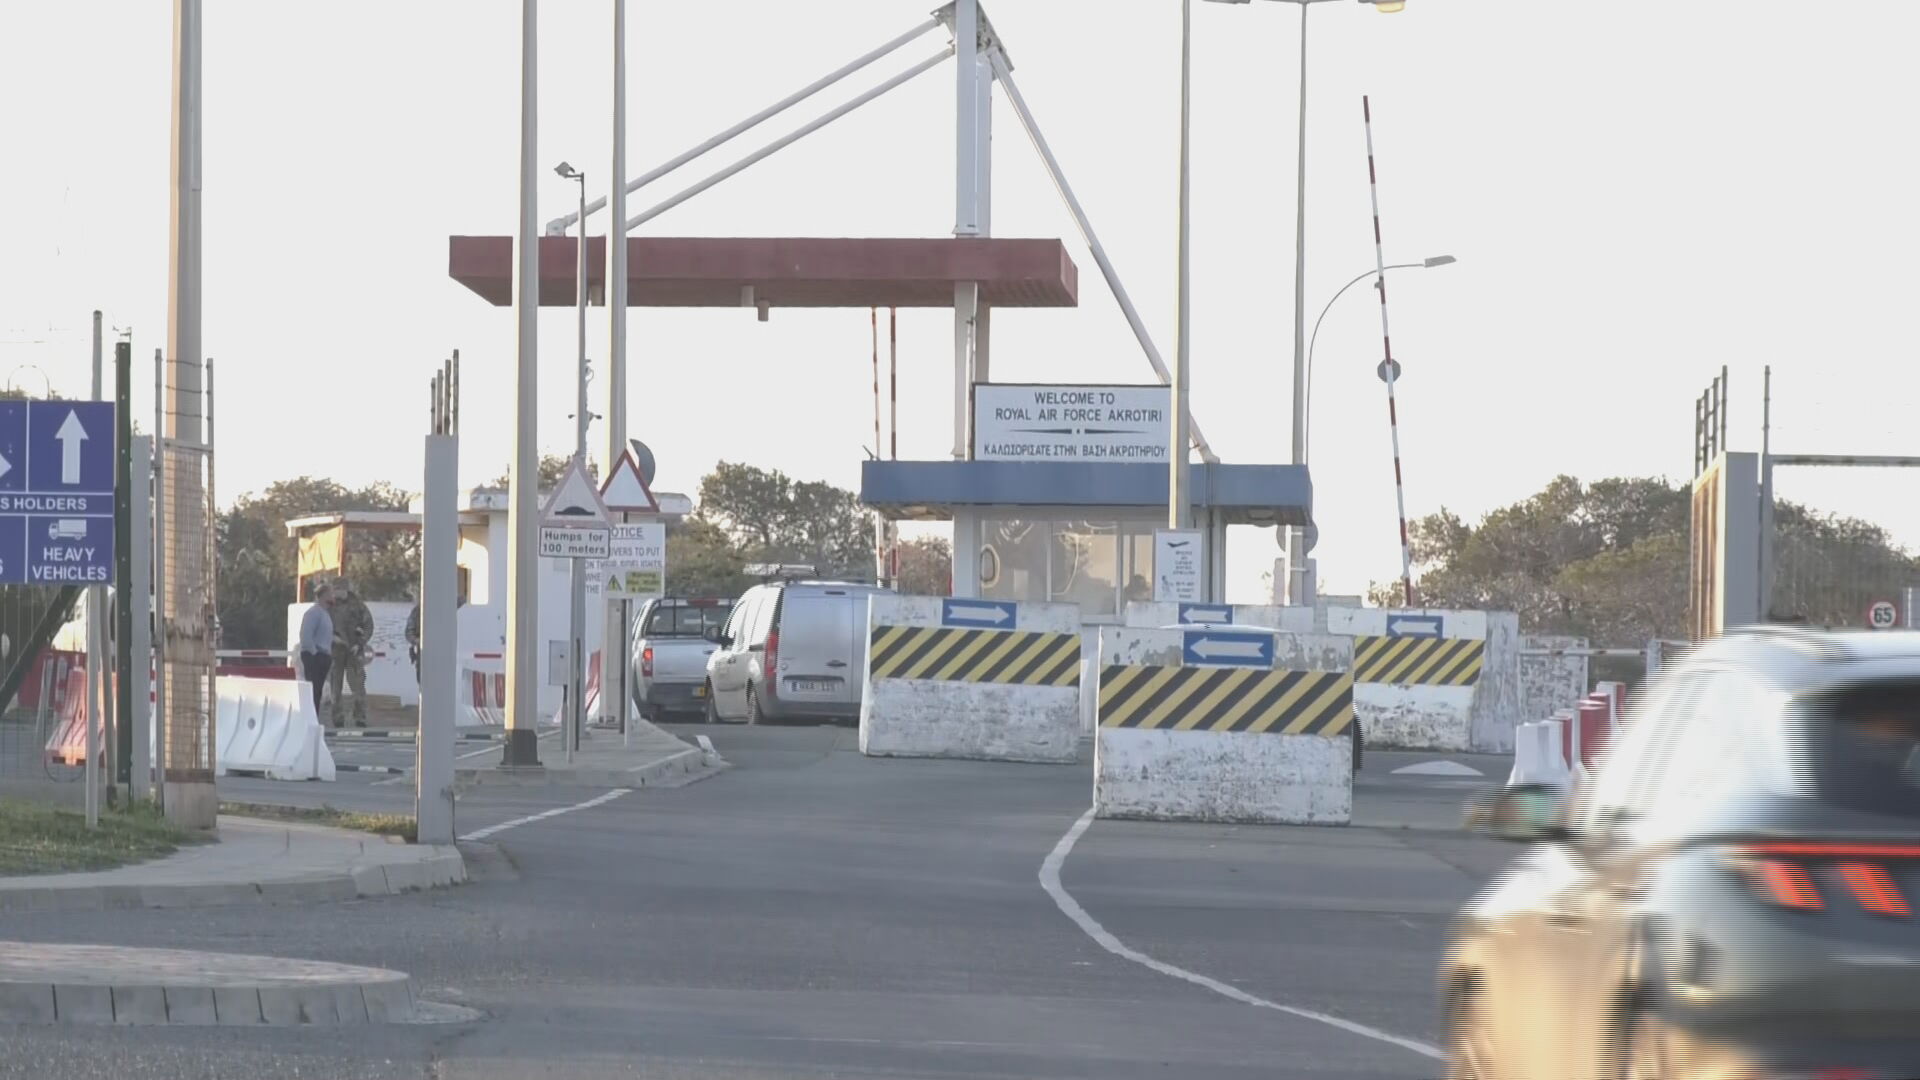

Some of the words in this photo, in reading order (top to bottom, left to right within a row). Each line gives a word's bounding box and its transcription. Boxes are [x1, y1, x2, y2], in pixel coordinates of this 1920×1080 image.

[1034, 391, 1095, 405] WELCOME
[1098, 392, 1115, 405] TO
[995, 408, 1031, 421] ROYAL
[1038, 408, 1057, 420] AIR
[1063, 408, 1101, 422] FORCE
[1108, 409, 1163, 423] AKROTIRI
[1053, 444, 1078, 456] ΣΤΗΝ
[1082, 444, 1107, 457] ΒΑΣΗ
[1109, 445, 1166, 457] ΑΚΡΩΤΗΡΙΟΥ
[0, 497, 10, 510] S
[14, 497, 87, 511] HOLDERS
[544, 530, 582, 542] Humps
[588, 532, 604, 542] for
[610, 527, 643, 538] OTICE
[43, 547, 95, 561] HEAVY
[543, 543, 562, 553] 100
[568, 545, 606, 555] meters
[635, 547, 645, 557] TO
[646, 547, 660, 557] PUT
[32, 565, 107, 580] VEHICLES
[1873, 607, 1893, 624] 65
